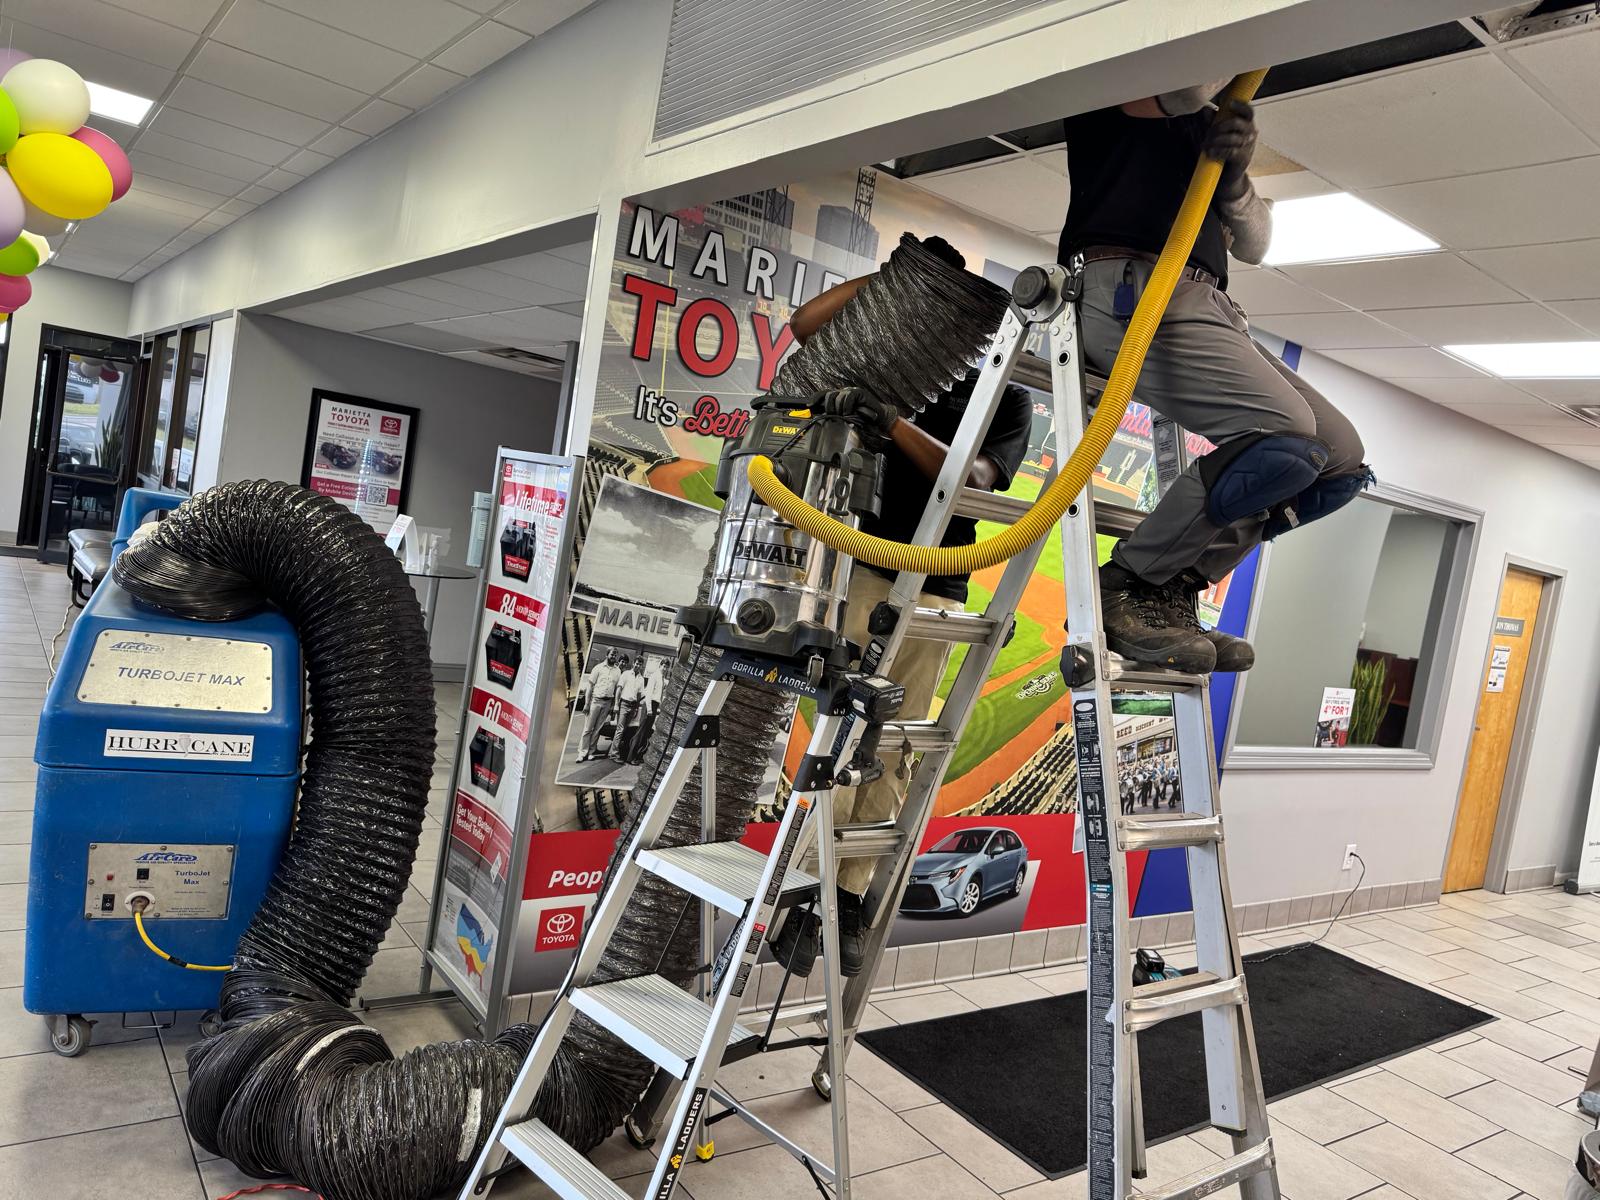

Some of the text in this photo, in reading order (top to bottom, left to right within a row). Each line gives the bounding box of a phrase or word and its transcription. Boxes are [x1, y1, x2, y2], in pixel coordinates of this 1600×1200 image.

[331, 406, 371, 418] MARIETTA
[331, 413, 370, 426] TOYOTA
[634, 385, 750, 438] It's Bett
[772, 425, 800, 435] DEWA
[515, 490, 549, 516] Lifetime
[734, 542, 807, 566] DEWALT
[500, 593, 517, 617] 84
[118, 666, 246, 686] TURBOJET MAX
[731, 661, 817, 694] GORILLA LADDERS
[483, 697, 502, 724] 60
[1331, 705, 1344, 715] FOR
[456, 804, 467, 817] Get
[467, 809, 478, 822] Your
[478, 815, 494, 838] Battery
[456, 814, 472, 833] Tested
[472, 822, 485, 844] Today
[132, 852, 199, 861] AirCare
[542, 934, 575, 944] TOYOTA
[677, 1093, 703, 1150] LADDERS
